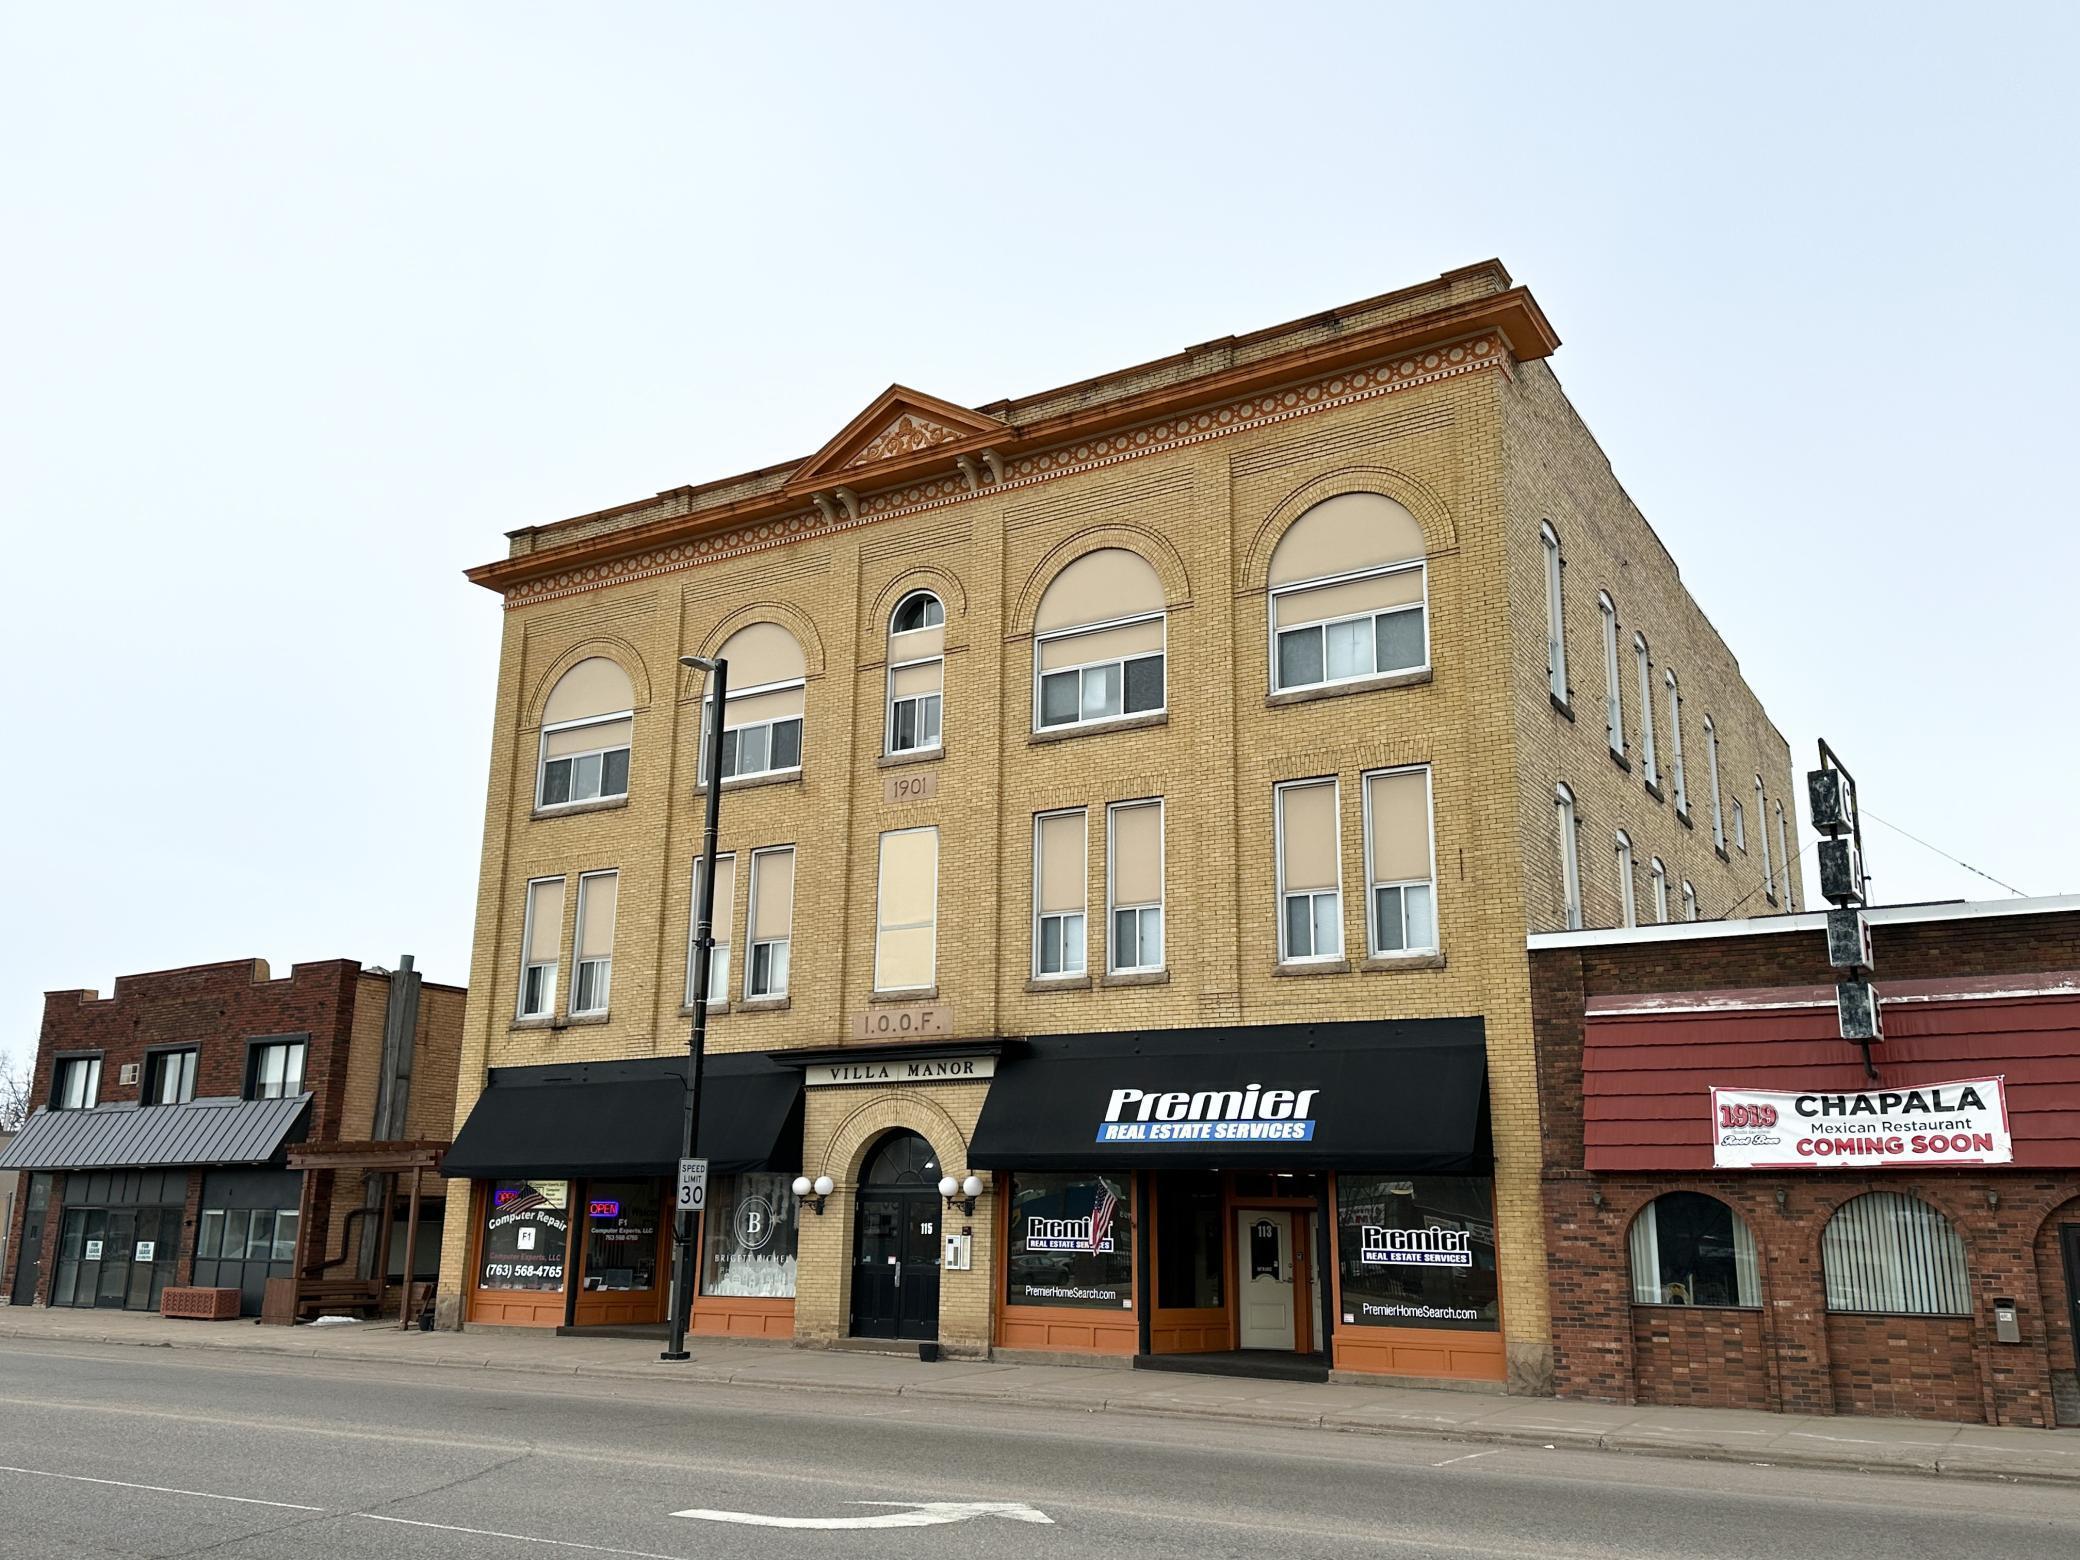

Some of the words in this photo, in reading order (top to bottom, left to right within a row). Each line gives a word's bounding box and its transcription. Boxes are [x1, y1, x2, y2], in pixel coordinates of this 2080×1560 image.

[893, 777, 926, 798] 1901
[865, 1012, 941, 1034] I.O.O.F.
[830, 1066, 889, 1081] VILLA
[908, 1061, 974, 1077] MANOR
[1104, 1083, 1320, 1122] Premier
[1795, 1086, 1987, 1118] CHAPALA
[1720, 1103, 1779, 1129] 1919
[1105, 1124, 1147, 1140] REAL
[1150, 1123, 1211, 1140] ESTATE
[1214, 1122, 1306, 1139] SERVICES
[1811, 1122, 1876, 1134] Mexican
[1882, 1118, 1973, 1133] Restaurant
[1796, 1136, 1905, 1157] COMING
[1911, 1133, 1994, 1154] SOON
[682, 1164, 706, 1173] SPEED
[683, 1175, 702, 1183] LIMIT
[681, 1185, 703, 1204] 30
[590, 1203, 616, 1214] OPEN
[488, 1211, 536, 1230] Computer
[536, 1211, 568, 1232] Repair
[747, 1212, 761, 1233] B
[920, 1222, 934, 1235] 115
[522, 1232, 532, 1241] F1
[1030, 1240, 1048, 1248] REAL
[1049, 1240, 1075, 1248] ESTATE
[1362, 1226, 1470, 1251] Premier
[548, 1253, 561, 1261] LLC
[1366, 1252, 1388, 1261] REAL
[1390, 1252, 1422, 1262] ESTATE
[1423, 1253, 1468, 1263] SERVICES
[486, 1264, 512, 1279] (763)
[514, 1265, 562, 1278] 568-4765
[1025, 1285, 1116, 1299] PremierHomeSearch.com
[1363, 1303, 1478, 1320] PremierHomeSearch.com
